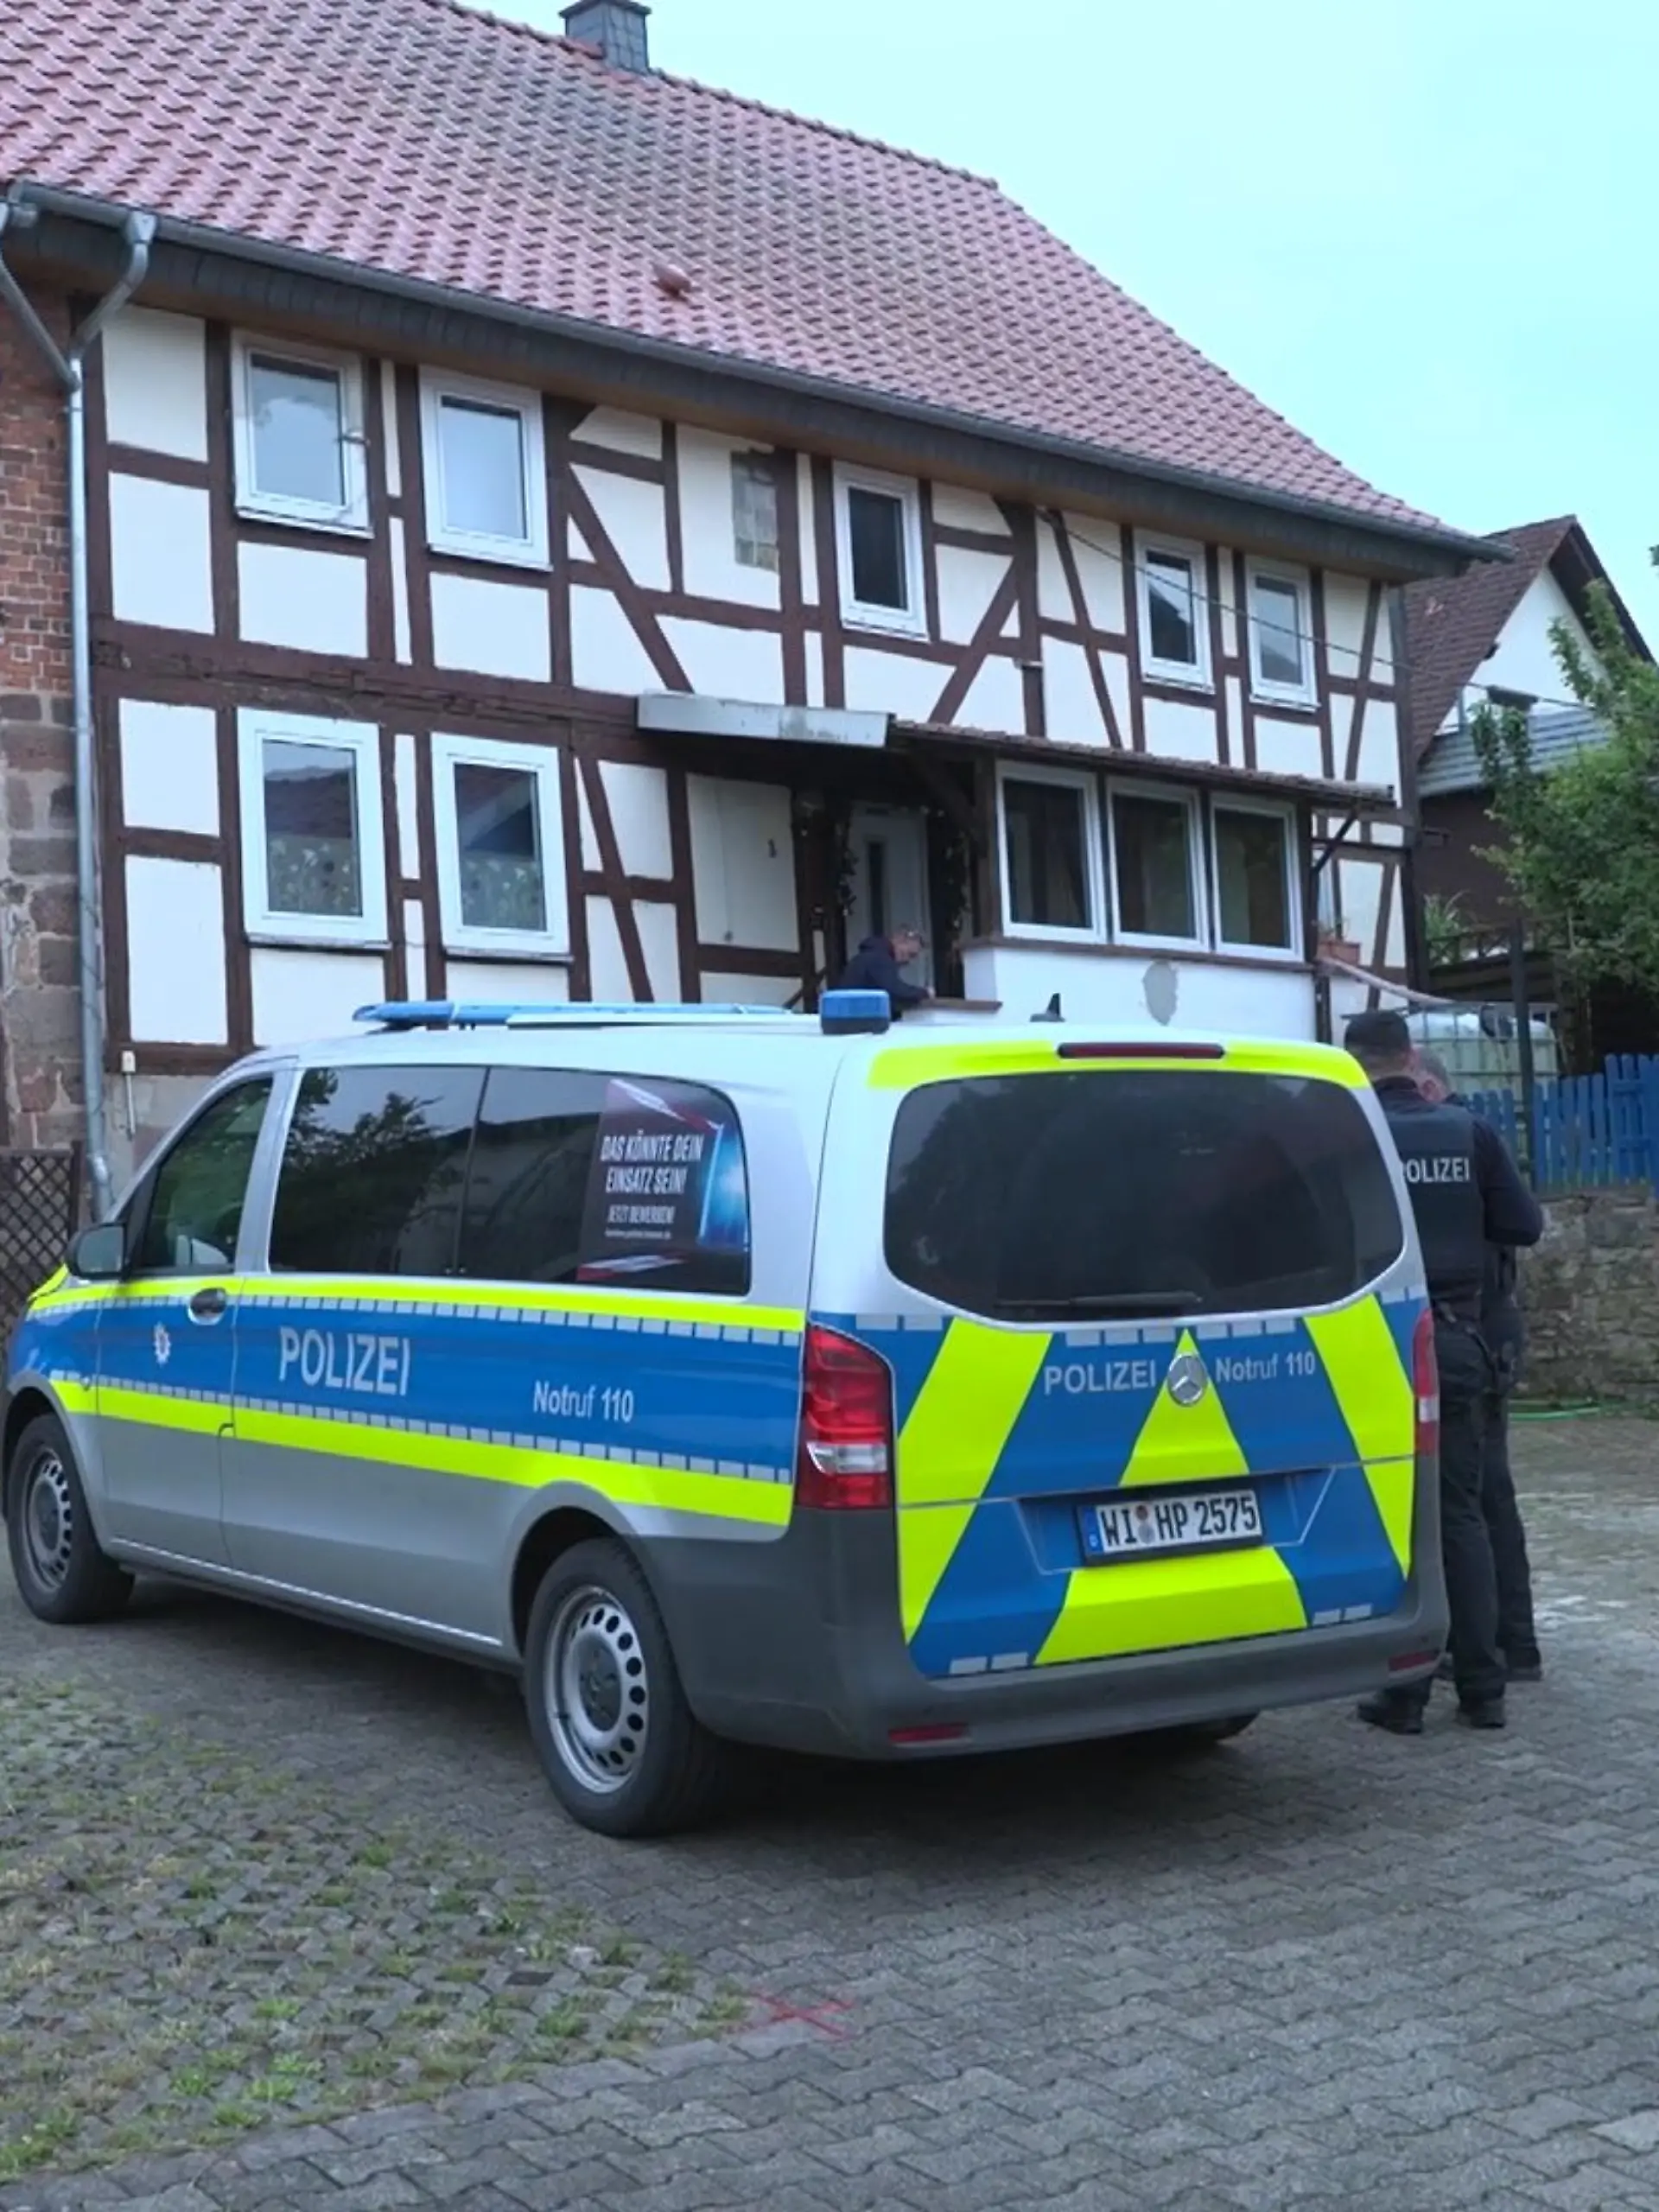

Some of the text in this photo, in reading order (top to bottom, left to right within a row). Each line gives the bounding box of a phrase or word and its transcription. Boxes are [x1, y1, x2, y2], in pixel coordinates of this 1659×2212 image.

[601, 1128, 705, 1162] DAS KÖNNTE DEIN
[606, 1166, 654, 1193] EINSATZ
[1403, 1157, 1470, 1184] OLIZEI
[278, 1326, 410, 1396] POLIZEI
[1044, 1359, 1156, 1395] POLIZEI
[1215, 1351, 1317, 1382] Notruf 110
[533, 1380, 634, 1424] Notruf 110
[1100, 1496, 1257, 1548] WI HP 2575
